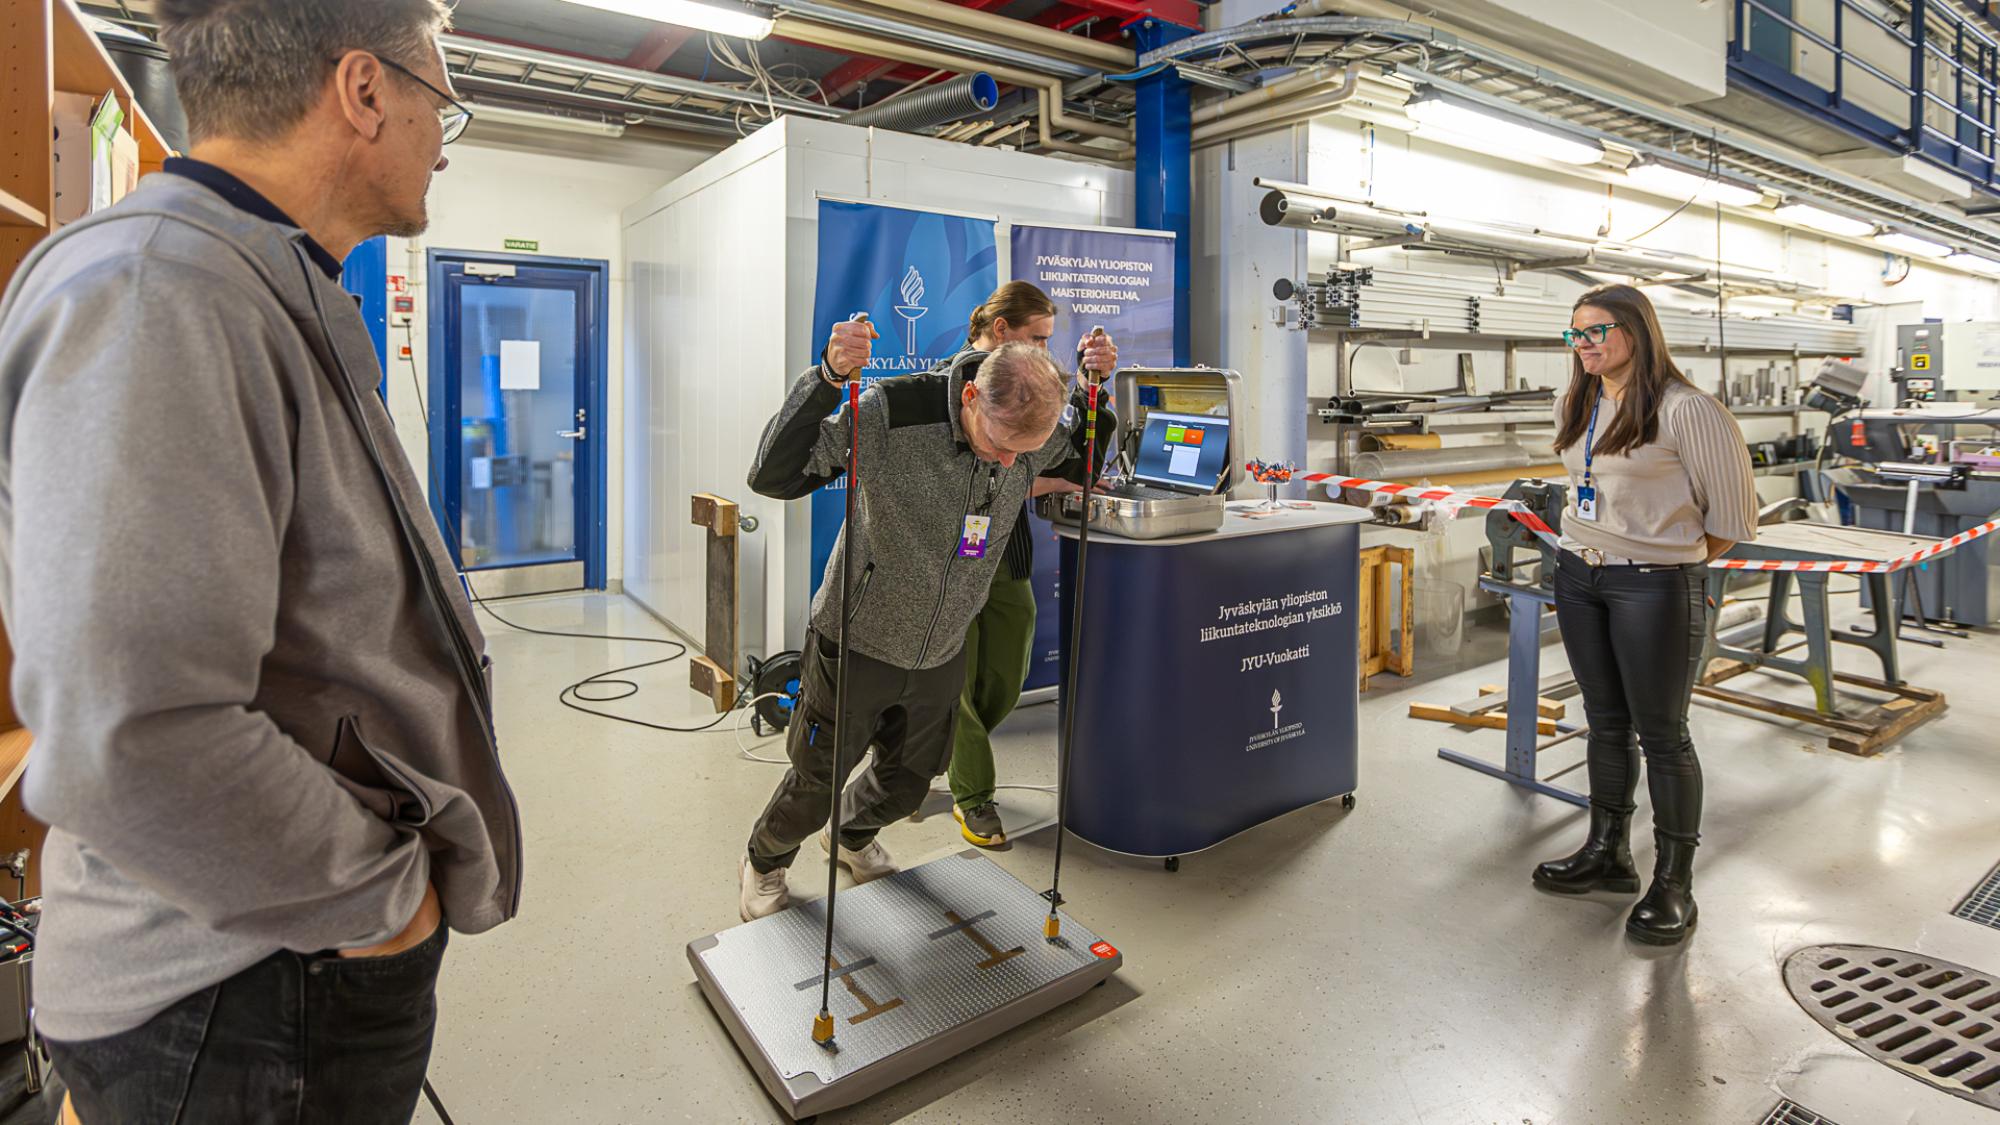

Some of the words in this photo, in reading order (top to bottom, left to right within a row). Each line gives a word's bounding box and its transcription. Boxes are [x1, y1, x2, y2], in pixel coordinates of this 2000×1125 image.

[1036, 254, 1098, 269] JYVÄSKYLÄN
[1099, 259, 1153, 272] YLIOPISTON
[1040, 271, 1150, 286] LIIKUNTATEKNOLOGIAN
[1051, 287, 1141, 301] MAISTERIOHJELMA,
[1072, 303, 1121, 315] VUOKATTI
[1218, 598, 1279, 621] Jyväskylän
[1280, 590, 1328, 610] yliopiston
[1200, 612, 1304, 642] liikuntateknologian
[1306, 602, 1342, 623] yksikkö
[1240, 644, 1310, 672] JYU-Vuokatti
